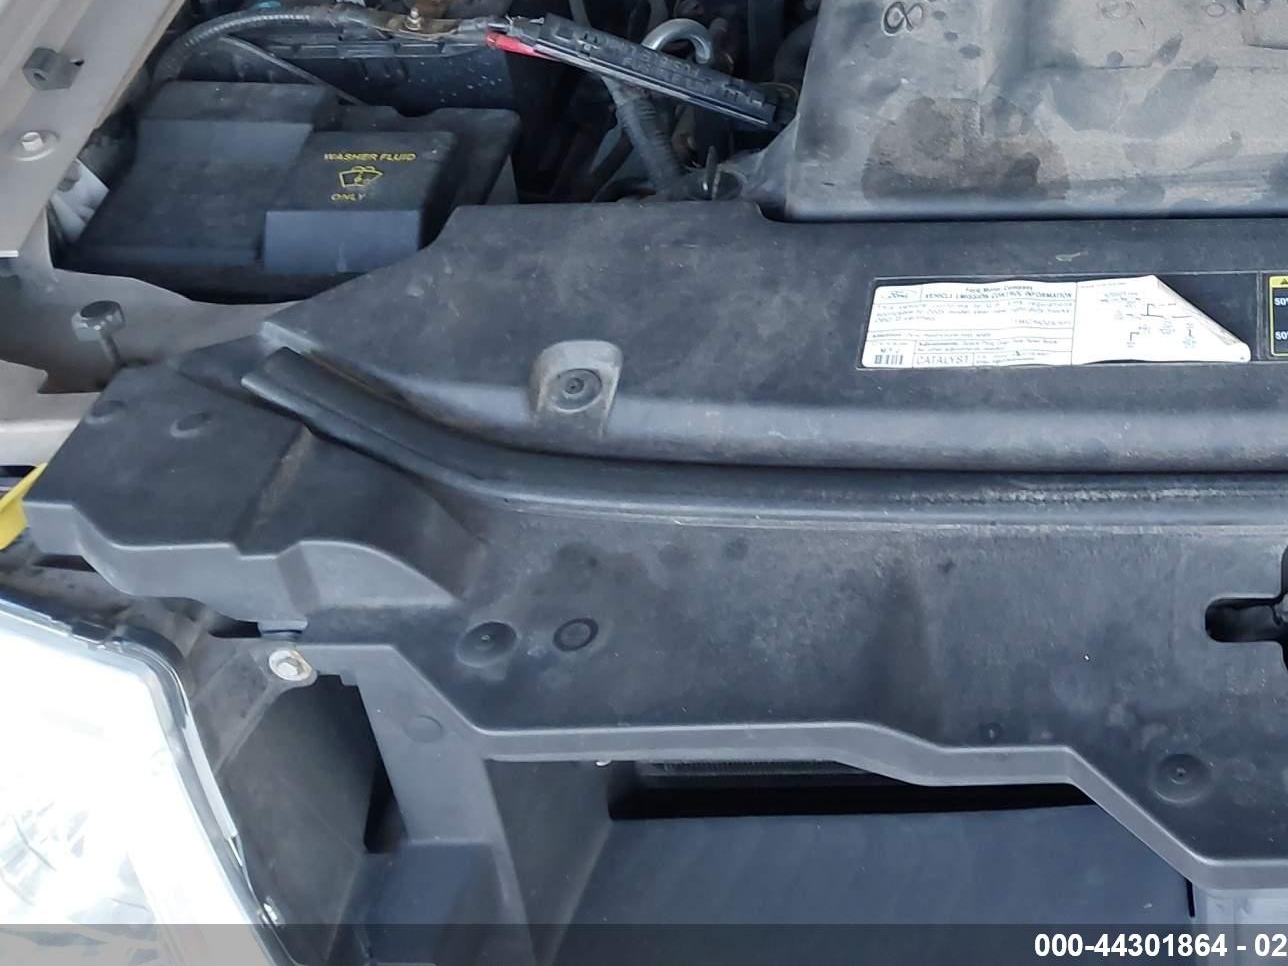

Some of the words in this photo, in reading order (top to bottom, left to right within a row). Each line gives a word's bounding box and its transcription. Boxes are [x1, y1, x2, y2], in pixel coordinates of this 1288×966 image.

[323, 153, 378, 161] WASHER
[380, 153, 417, 161] FLUID
[330, 193, 366, 201] ONLY
[916, 354, 969, 364] CATALYST
